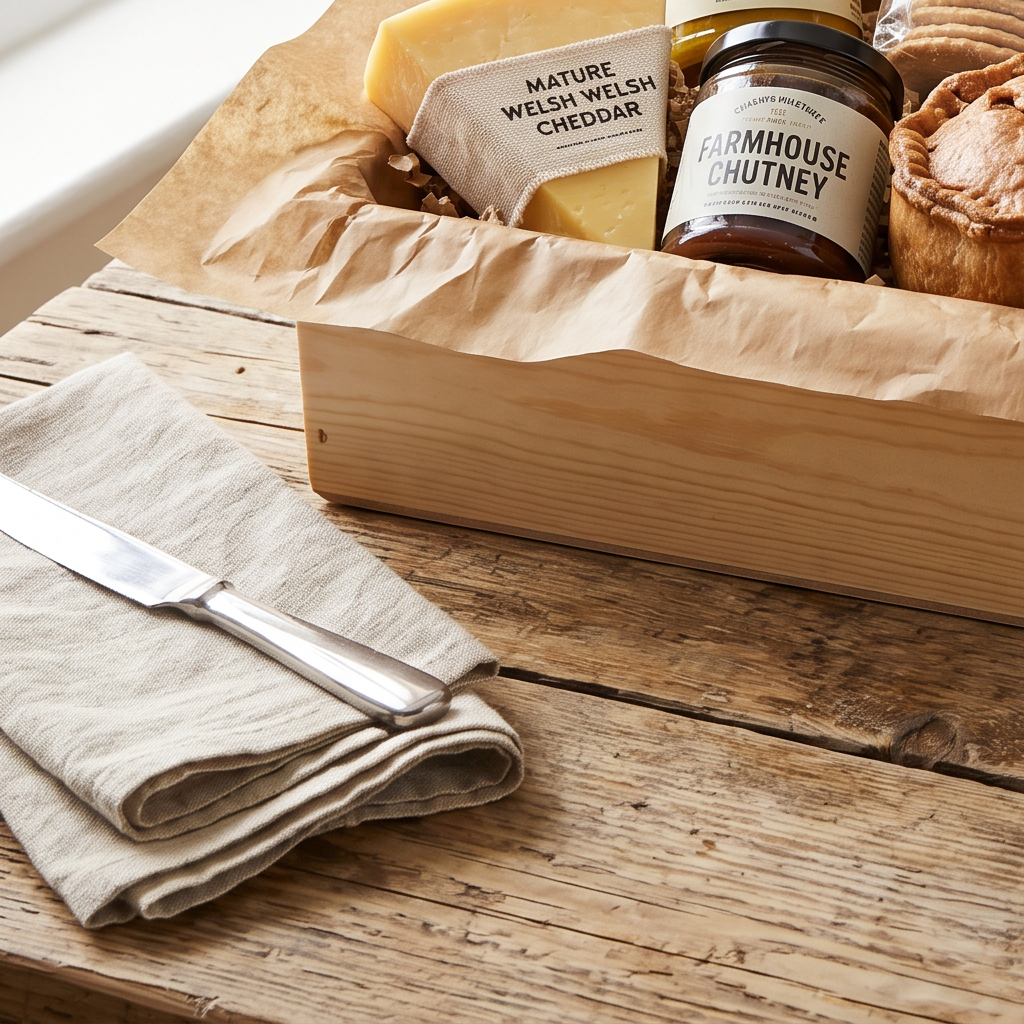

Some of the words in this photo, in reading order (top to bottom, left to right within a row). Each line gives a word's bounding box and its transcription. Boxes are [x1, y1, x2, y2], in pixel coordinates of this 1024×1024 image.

[525, 61, 616, 94] MATURE
[500, 92, 578, 122] WELSH
[579, 75, 657, 103] WELSH
[536, 101, 642, 136] CHEDDAR
[698, 129, 850, 181] FARMHOUSE
[707, 159, 828, 200] CHUTNEY
